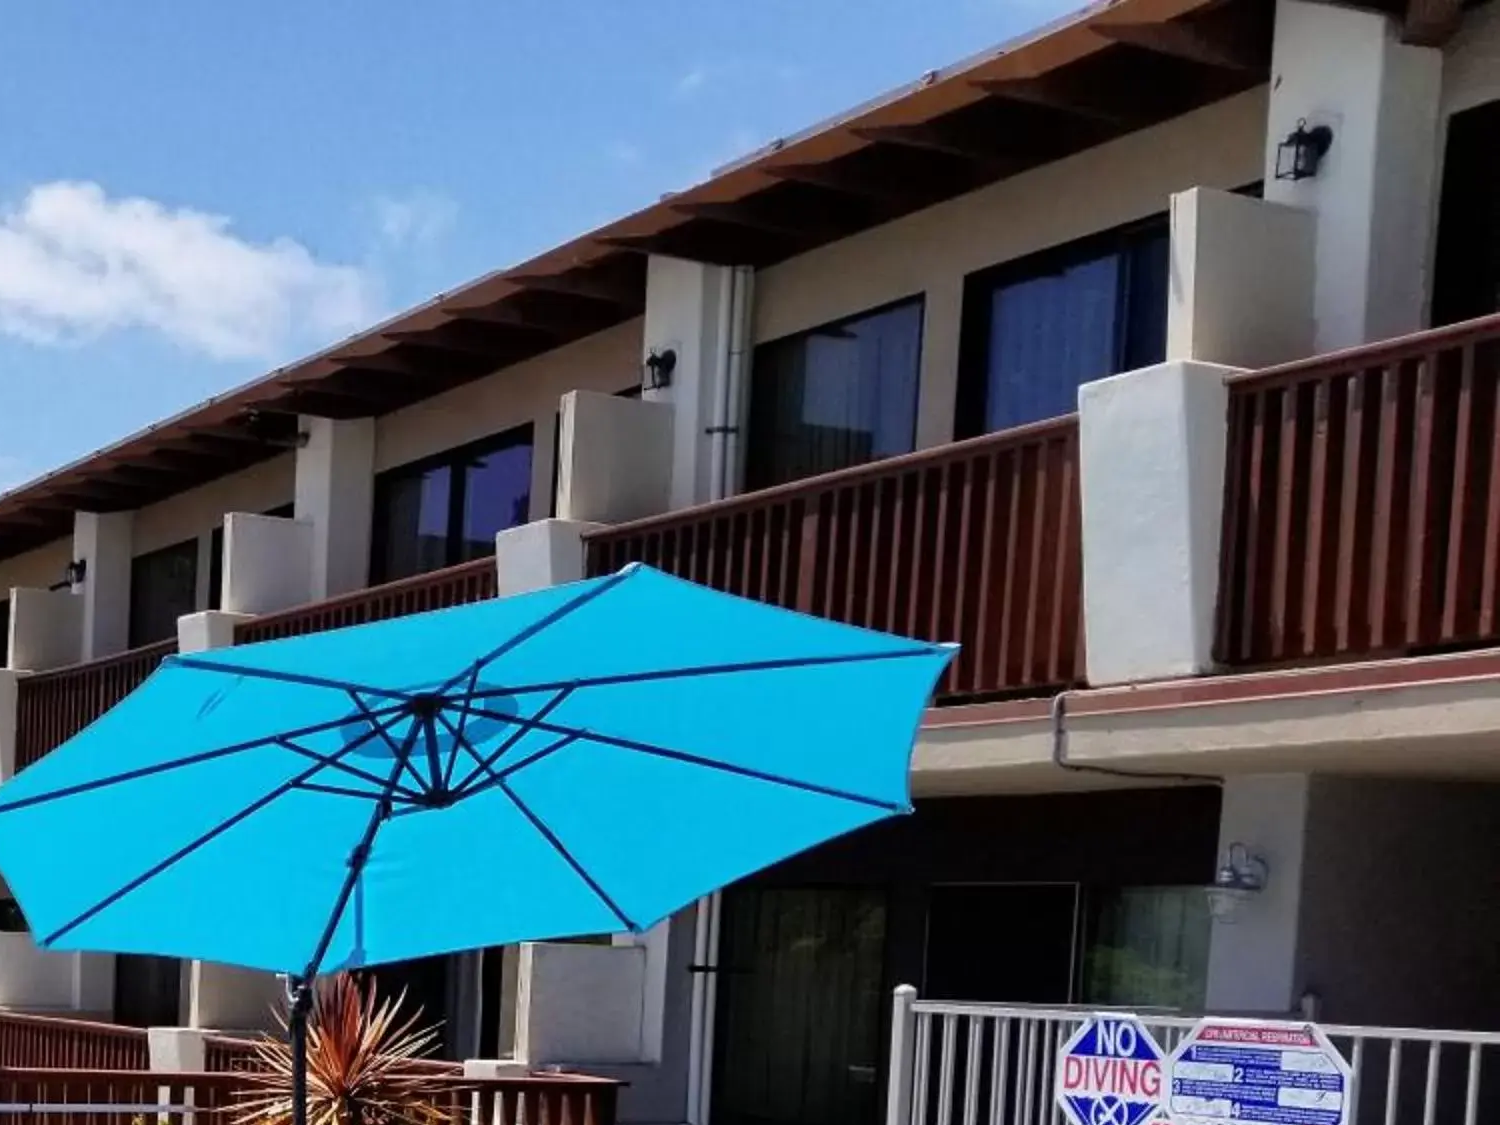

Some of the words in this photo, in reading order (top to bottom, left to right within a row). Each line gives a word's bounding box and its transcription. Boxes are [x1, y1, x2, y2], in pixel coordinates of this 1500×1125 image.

[1096, 1020, 1137, 1057] NO
[1063, 1056, 1162, 1097] DIVING
[1234, 1067, 1244, 1083] 2
[1173, 1079, 1181, 1095] 3
[1231, 1101, 1241, 1118] 4
